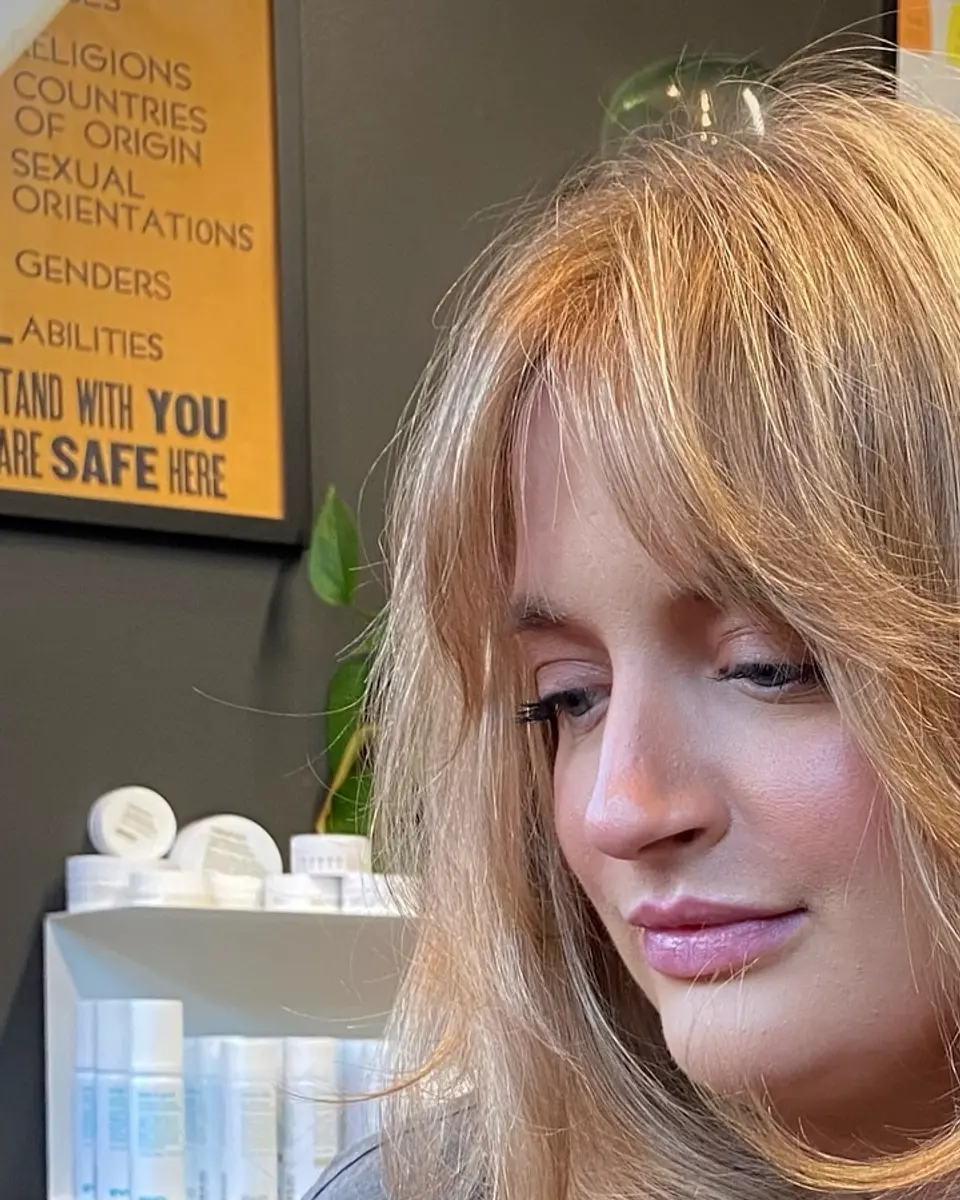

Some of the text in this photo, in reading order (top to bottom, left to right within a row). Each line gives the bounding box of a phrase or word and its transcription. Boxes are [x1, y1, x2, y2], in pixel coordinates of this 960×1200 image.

[13, 70, 207, 134] COUNTRIES
[14, 105, 202, 168] OF ORIGIN
[11, 147, 145, 199] SEXUAL
[12, 184, 254, 251] ORIENTATIONS
[15, 249, 172, 301] GENDERS
[20, 315, 164, 361] ABILITIES
[76, 376, 133, 431] WITH
[147, 387, 227, 440] YOU
[51, 435, 159, 491] SAFE
[168, 447, 227, 500] HERE
